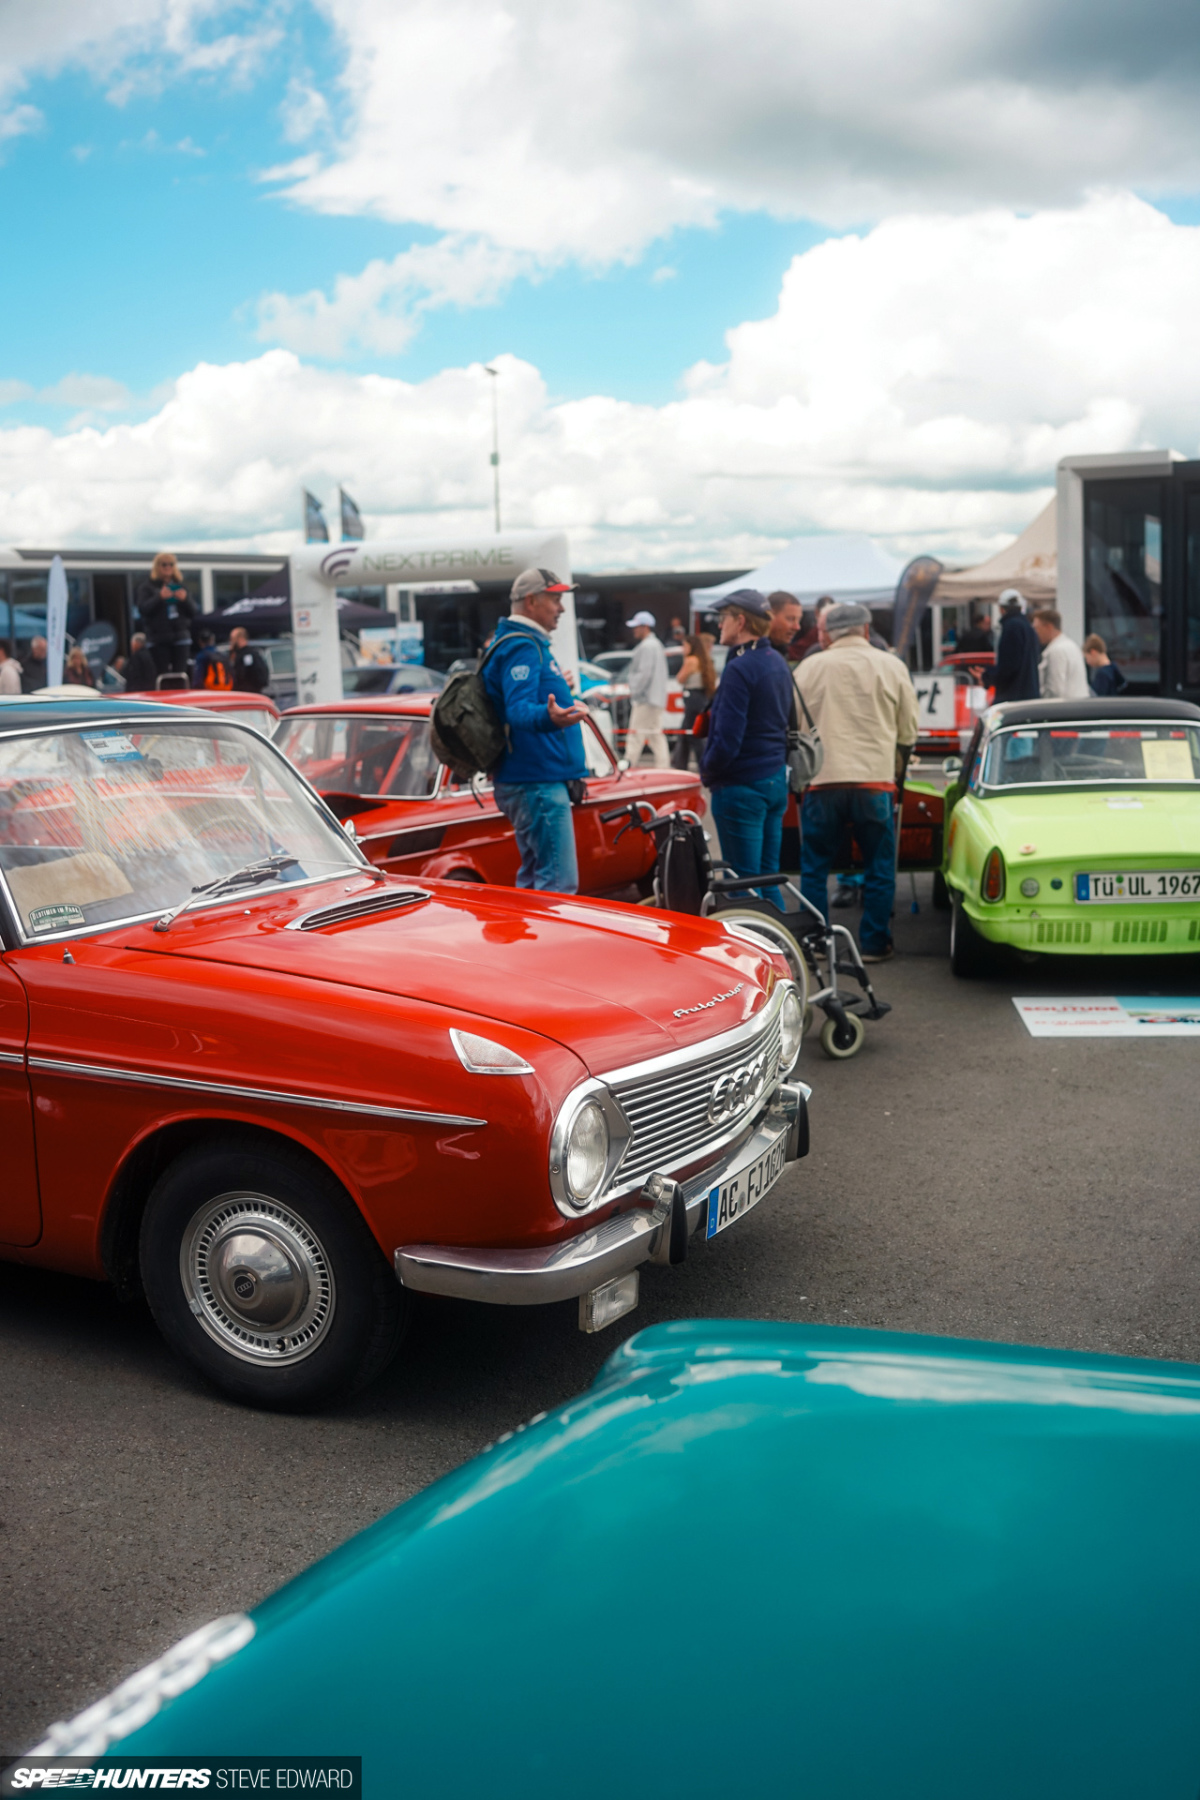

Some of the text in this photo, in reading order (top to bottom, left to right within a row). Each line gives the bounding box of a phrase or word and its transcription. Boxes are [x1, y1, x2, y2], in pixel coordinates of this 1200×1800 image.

[363, 548, 513, 571] NEXTPRIME
[1091, 875, 1200, 896] TÜ UL 1967
[718, 1180, 739, 1226] AC
